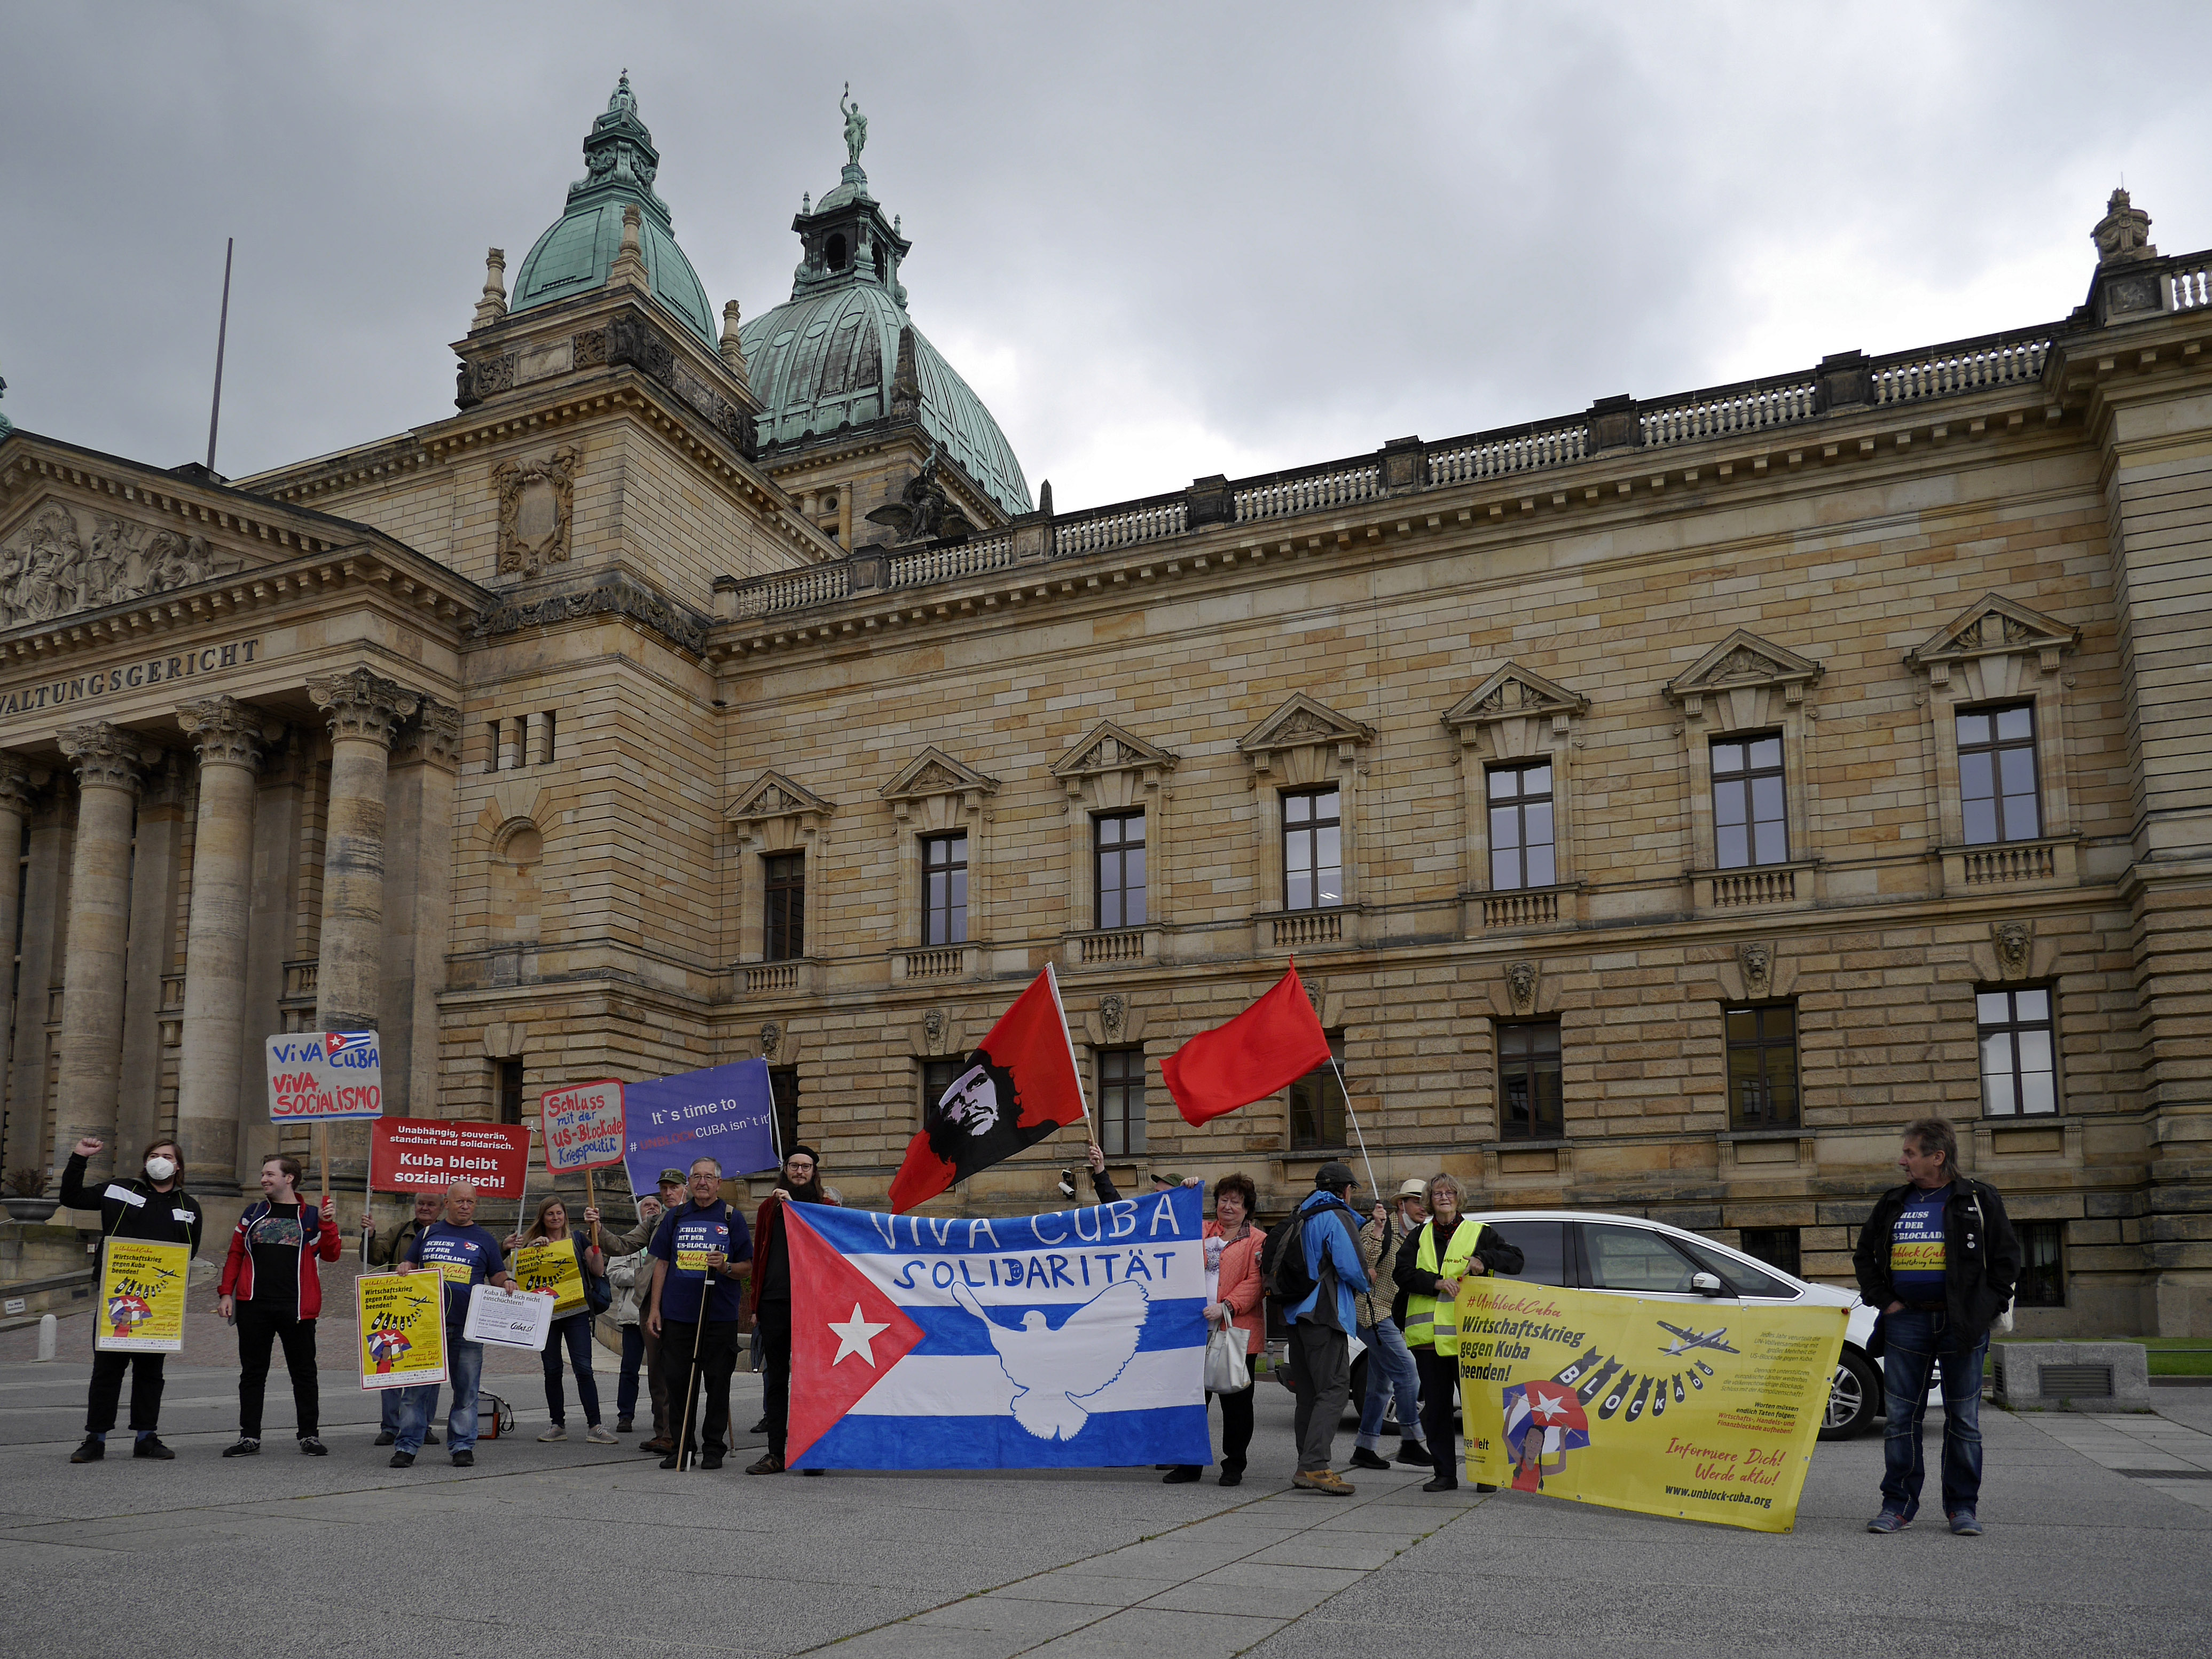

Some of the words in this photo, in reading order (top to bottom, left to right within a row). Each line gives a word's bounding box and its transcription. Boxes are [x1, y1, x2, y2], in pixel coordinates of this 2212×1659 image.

[548, 1092, 605, 1117] Schluss
[683, 1103, 717, 1118] time
[720, 1099, 736, 1111] to
[557, 1112, 574, 1126] mit
[578, 1111, 597, 1122] der
[398, 1126, 458, 1138] Unabhängig,
[461, 1131, 508, 1141] souverän,
[390, 1135, 437, 1145] standhaft
[460, 1140, 514, 1150] solidarisch.
[400, 1153, 443, 1167] Kuba
[449, 1155, 498, 1170] bleibt
[870, 1212, 1000, 1249] VIVA
[1031, 1193, 1180, 1245] CUBA
[113, 1254, 162, 1263] Wirtschaftskrieg
[516, 1263, 530, 1271] gegen
[517, 1267, 539, 1275] beenden!
[892, 1249, 1175, 1289] SOLIDARITÄT
[365, 1286, 413, 1295] Wirtschaftskrieg
[483, 1295, 524, 1306] einschüchtern!
[1466, 1293, 1562, 1318] #UnblockCuba
[1462, 1316, 1586, 1348] Wirtschaftskrieg
[1460, 1341, 1494, 1359] gegen
[1495, 1341, 1531, 1360] Kuba
[1750, 1352, 1783, 1361] US-Blockade
[1460, 1361, 1512, 1382] beenden!
[1757, 1388, 1803, 1398] Komplizenschaft!
[1718, 1412, 1755, 1423] Wirtschafts-,
[1756, 1417, 1783, 1425] Handels-
[1775, 1411, 1797, 1419] folgen:
[1717, 1420, 1762, 1431] Finanzblockade
[1763, 1426, 1793, 1434] aufheben!
[1473, 1437, 1489, 1450] Welt
[1665, 1437, 1738, 1462] Informiere
[1743, 1448, 1786, 1467] Dich!
[1695, 1463, 1735, 1481] Werde
[1740, 1467, 1780, 1486] aktiv!
[1665, 1485, 1772, 1509] www.unblock-cuba.org
